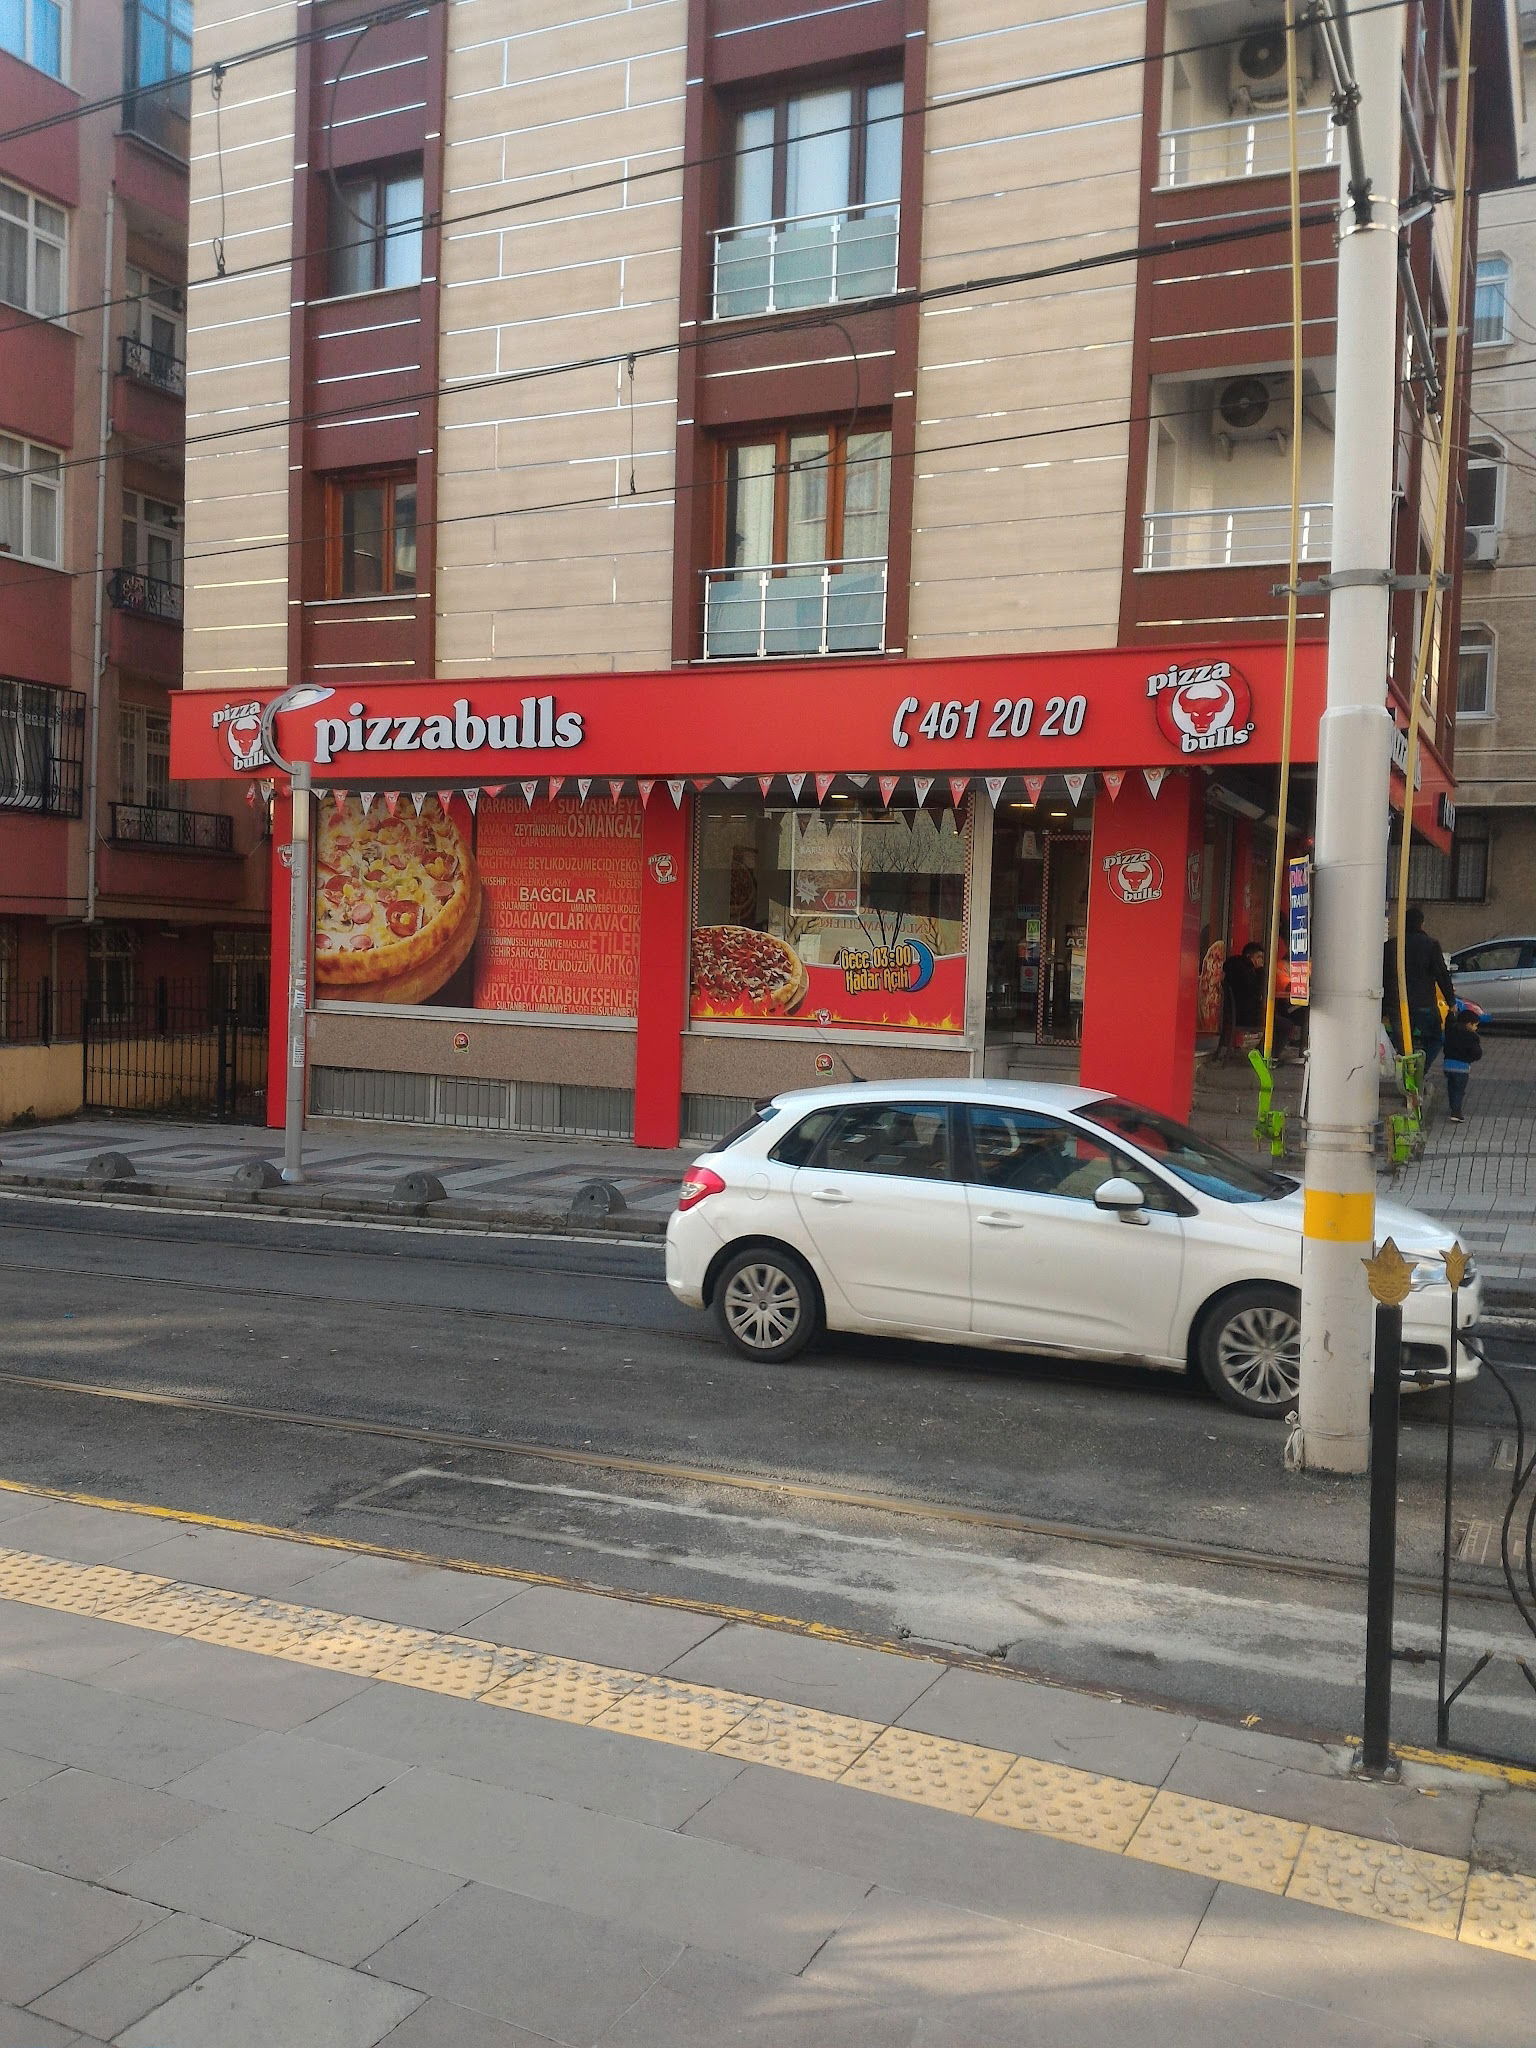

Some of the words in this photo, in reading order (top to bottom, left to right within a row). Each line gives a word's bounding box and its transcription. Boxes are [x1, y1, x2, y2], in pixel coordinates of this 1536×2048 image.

[1147, 662, 1231, 697] pizza
[212, 702, 260, 728] pizza
[918, 700, 980, 739] 461
[988, 697, 1034, 738] 20
[1039, 695, 1087, 736] 20
[314, 695, 583, 763] pizzabulls
[1181, 726, 1249, 753] bulls
[1104, 851, 1150, 871] pizza
[1123, 887, 1161, 902] bulls
[531, 913, 585, 930] AVCILAR
[585, 913, 641, 932] KAVACIK
[508, 958, 538, 970] KARTAL
[841, 948, 870, 970] Gece
[872, 945, 912, 967] 03:00
[846, 969, 880, 995] Kadar
[590, 986, 639, 1008] ESENLER
